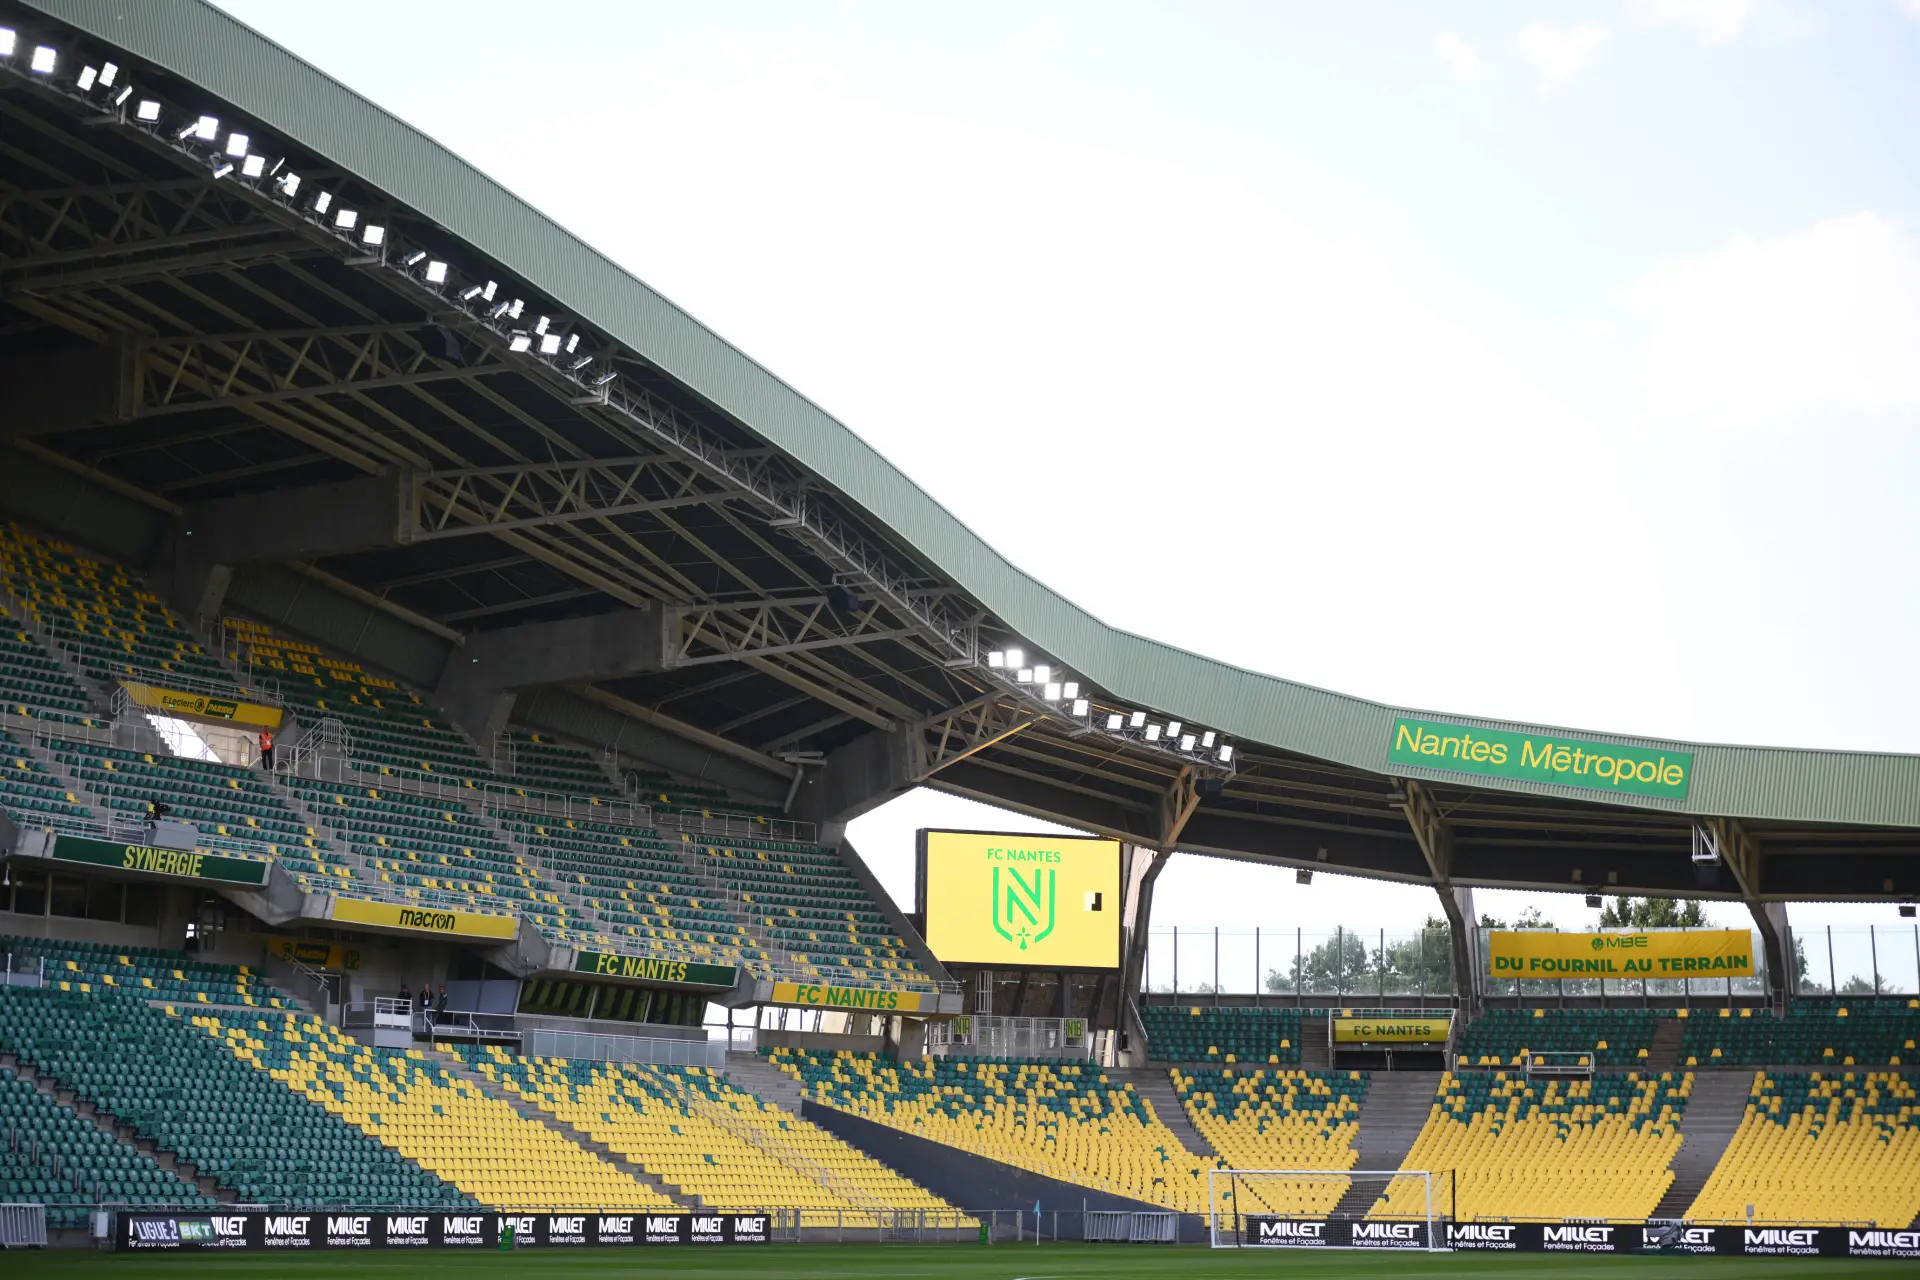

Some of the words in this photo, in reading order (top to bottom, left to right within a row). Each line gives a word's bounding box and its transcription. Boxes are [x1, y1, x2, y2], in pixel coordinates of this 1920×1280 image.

[1396, 725, 1508, 764] Nantes
[123, 845, 203, 877] SYNERGIE
[987, 848, 1004, 860] FC
[1007, 849, 1062, 863] NANTES
[399, 909, 456, 930] macron
[1606, 936, 1648, 948] MBE
[596, 953, 619, 975] FC
[622, 957, 688, 982] NANTES
[1495, 956, 1524, 970] DU
[1530, 957, 1618, 973] FOURNIL
[1624, 958, 1652, 972] AU
[1658, 954, 1748, 971] TERRAIN
[796, 984, 822, 1004] FC
[825, 987, 899, 1010] NANTES
[1067, 1020, 1083, 1037] N1B
[1354, 1025, 1372, 1036] FC
[1376, 1025, 1431, 1036] NANTES
[135, 1221, 168, 1240] LIGUE
[169, 1219, 179, 1240] 2
[180, 1224, 211, 1237] BKT
[265, 1217, 310, 1235] MILLET
[327, 1217, 371, 1234] MILLET
[387, 1217, 429, 1234] MILLET
[444, 1217, 483, 1234] MILLET
[550, 1217, 585, 1233] MILLET
[599, 1217, 634, 1233] MILLET
[646, 1217, 680, 1233] MILLET
[692, 1218, 724, 1232] MILLET
[735, 1218, 765, 1232] MILLET
[1260, 1222, 1325, 1238] MILLET
[1353, 1223, 1420, 1238] MILLET
[1447, 1225, 1515, 1240] MILLET
[1289, 1238, 1296, 1246] et
[1544, 1227, 1614, 1242] MILLET
[1745, 1229, 1819, 1245] MILLET
[1382, 1239, 1389, 1247] et
[1477, 1240, 1484, 1249] et
[1575, 1242, 1582, 1250] et
[1777, 1246, 1785, 1254] et
[1883, 1248, 1891, 1256] et
[1892, 1249, 1920, 1258] Façade
